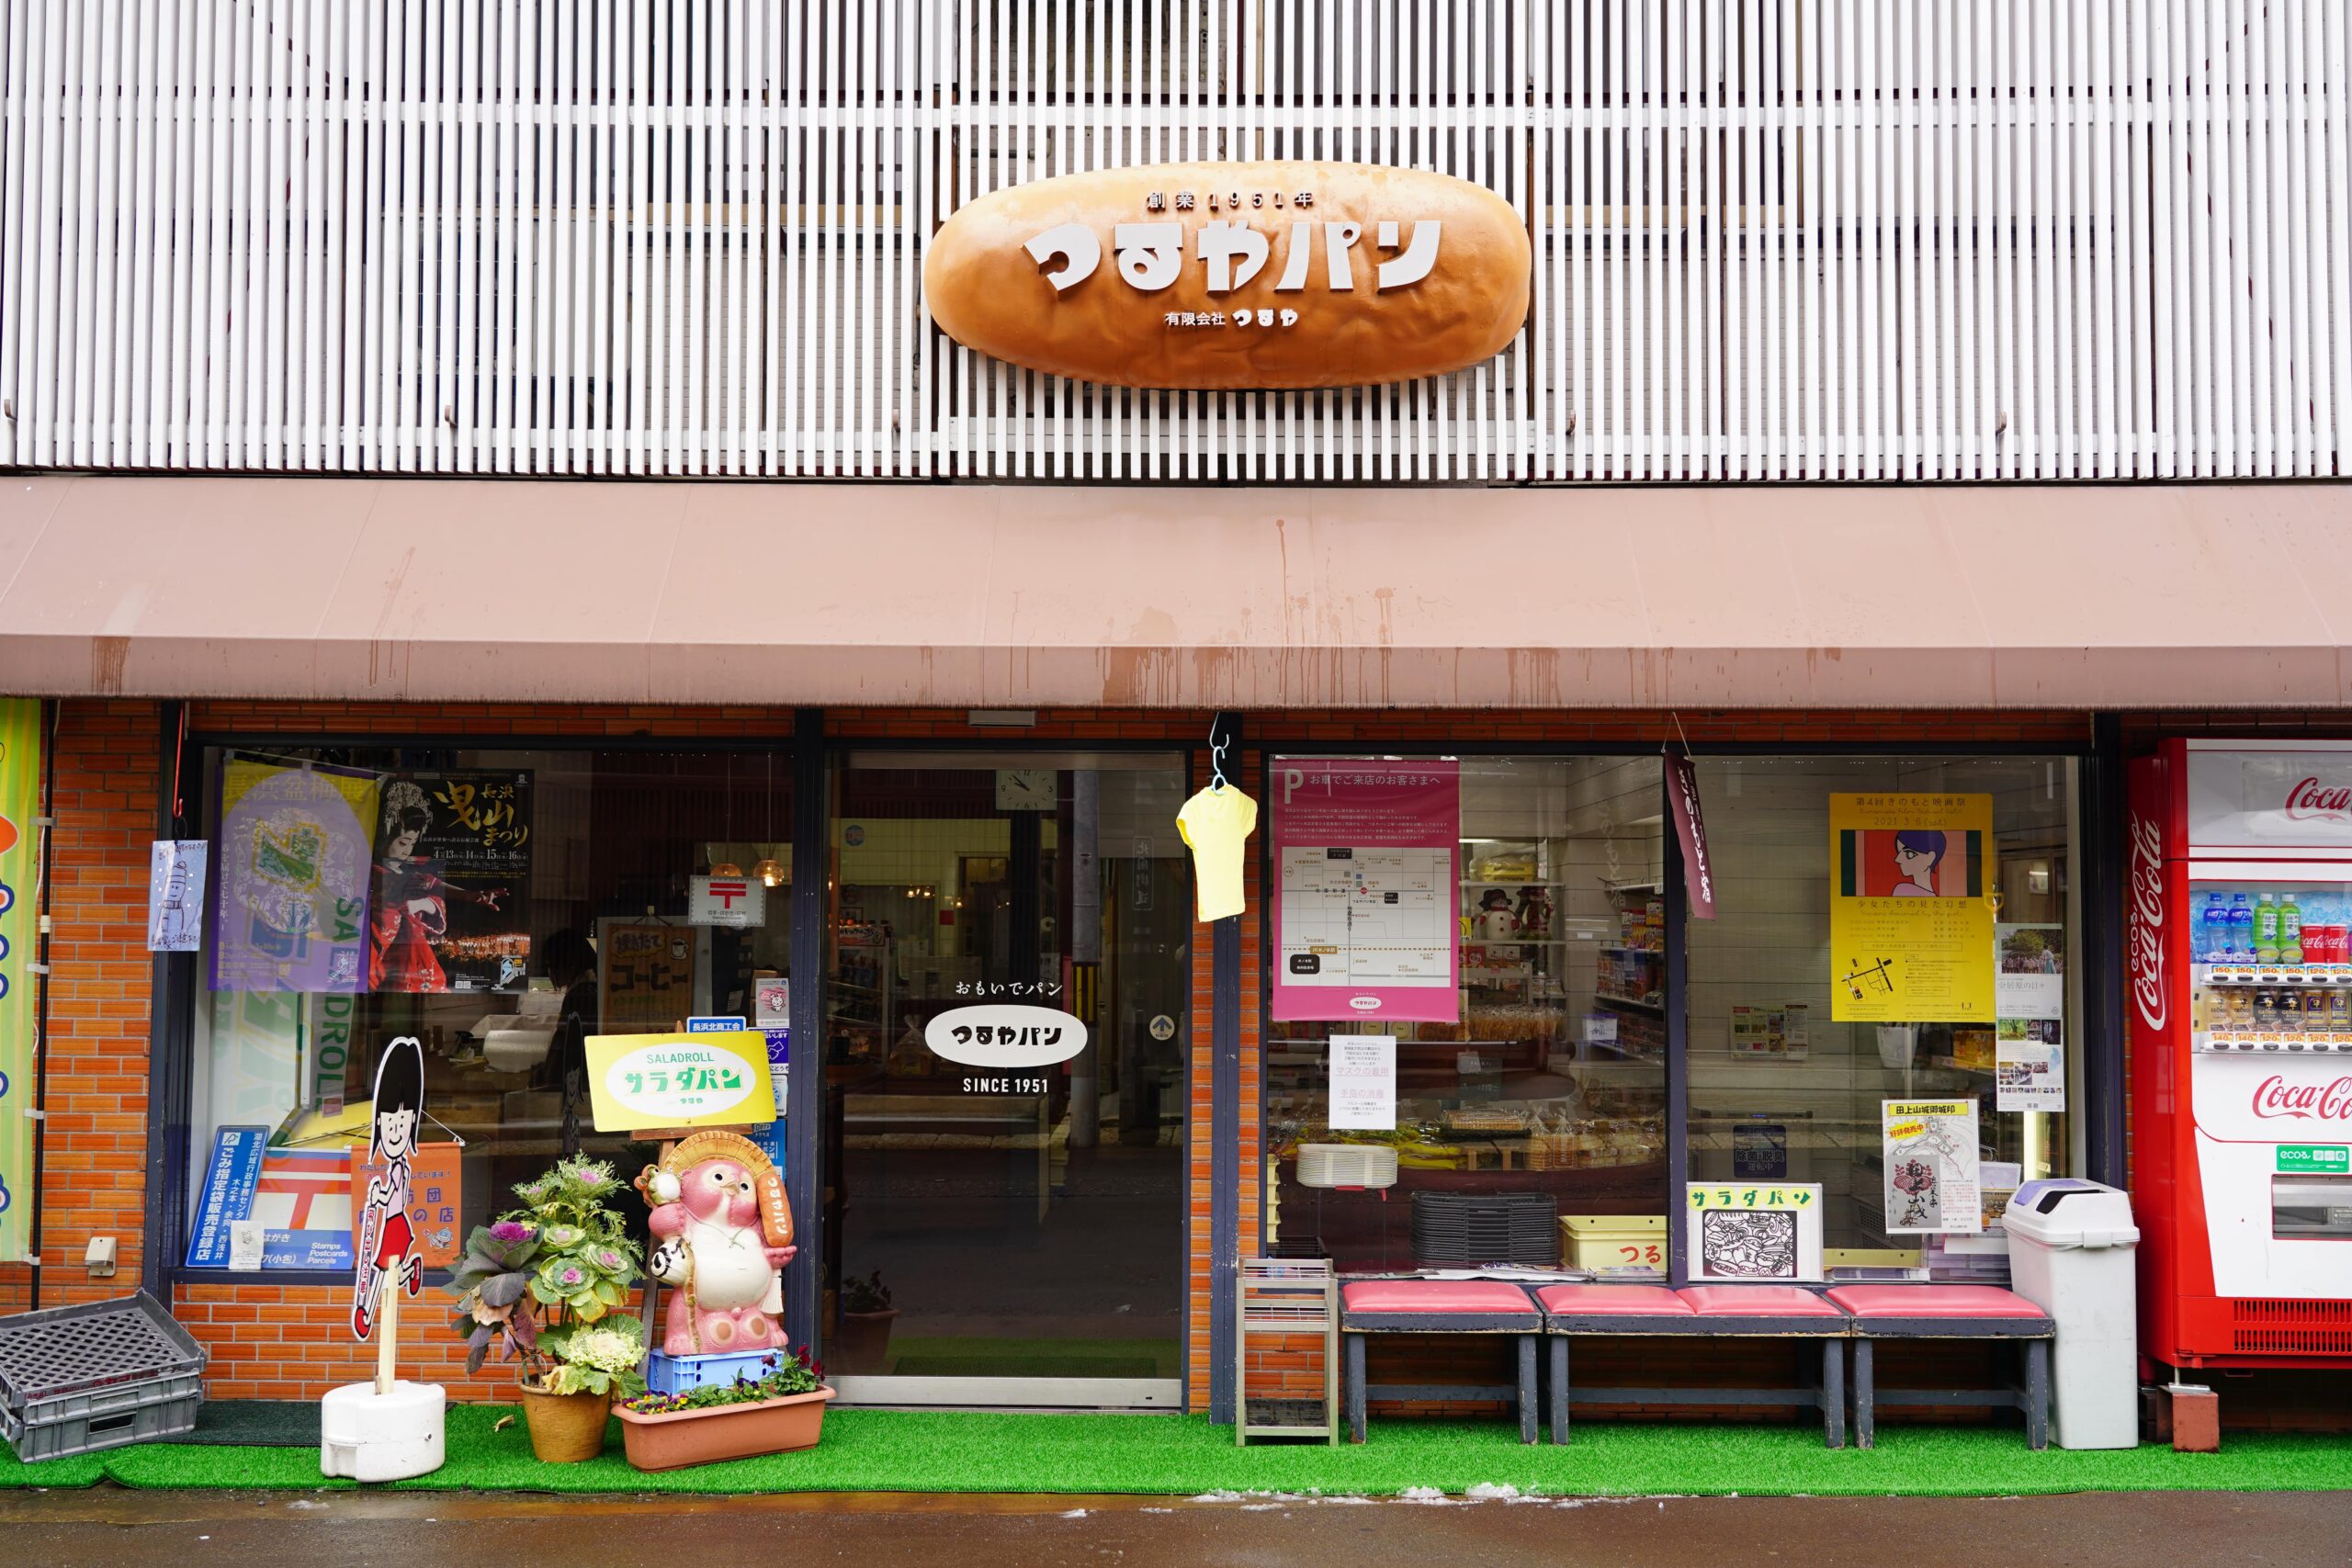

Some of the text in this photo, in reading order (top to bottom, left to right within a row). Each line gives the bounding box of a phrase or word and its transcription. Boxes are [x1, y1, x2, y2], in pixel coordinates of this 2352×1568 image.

[1020, 220, 1442, 302] つるやパン
[1164, 309, 1299, 327] 有限会社 つるや
[481, 783, 514, 799] 長浜
[1284, 769, 1304, 804] P
[1888, 797, 1966, 806] きのもと映画祭
[2285, 777, 2352, 821] Coca
[483, 826, 528, 847] まつり
[1858, 900, 1967, 908] 少女たちの見た幻想
[609, 963, 689, 993] コーヒー
[956, 981, 1063, 997] おもいでパン
[693, 1022, 741, 1032] 長浜北商工会
[951, 1025, 1062, 1046] つるやパン
[646, 1052, 715, 1065] SALADROLL
[624, 1066, 742, 1095] サラダパン
[963, 1077, 1048, 1093] SINCE 1951
[1895, 1105, 1956, 1114] 田上山城御城印
[1889, 1123, 1924, 1138] 好評発売中
[1735, 1150, 1784, 1162] 除菌・脱臭
[235, 1133, 263, 1220] 湖北広域行政事務センタ
[196, 1147, 235, 1261] ごみ指定袋販売登録店
[1691, 1190, 1812, 1207] サラダパン
[311, 1242, 341, 1250] Stamps
[307, 1257, 336, 1265] Parcels
[1619, 1245, 1662, 1264] つる
